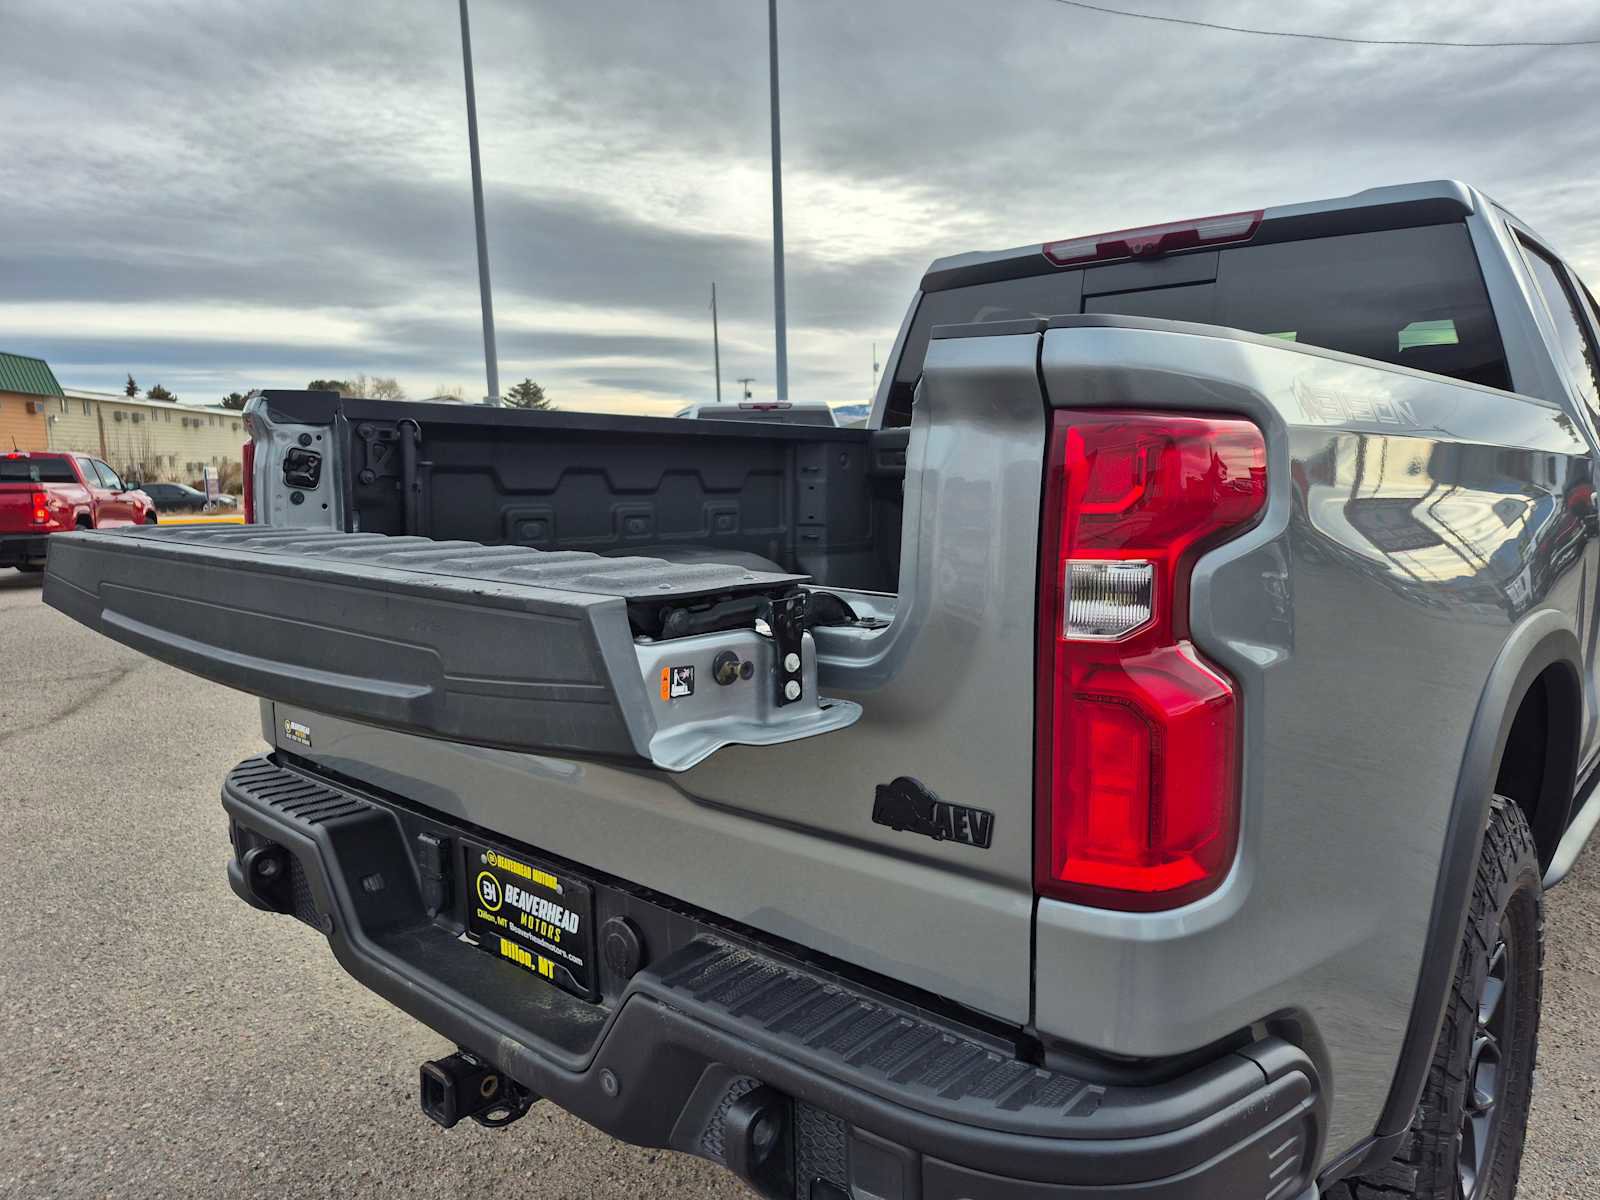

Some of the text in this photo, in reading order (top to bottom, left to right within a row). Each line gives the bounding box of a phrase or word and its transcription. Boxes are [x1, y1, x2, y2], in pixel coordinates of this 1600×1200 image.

[934, 803, 992, 846] AEV
[497, 916, 508, 928] MT
[504, 883, 580, 934] BEAVERHEAD
[520, 912, 561, 943] MOTORS
[500, 938, 555, 979] Dillon, MT
